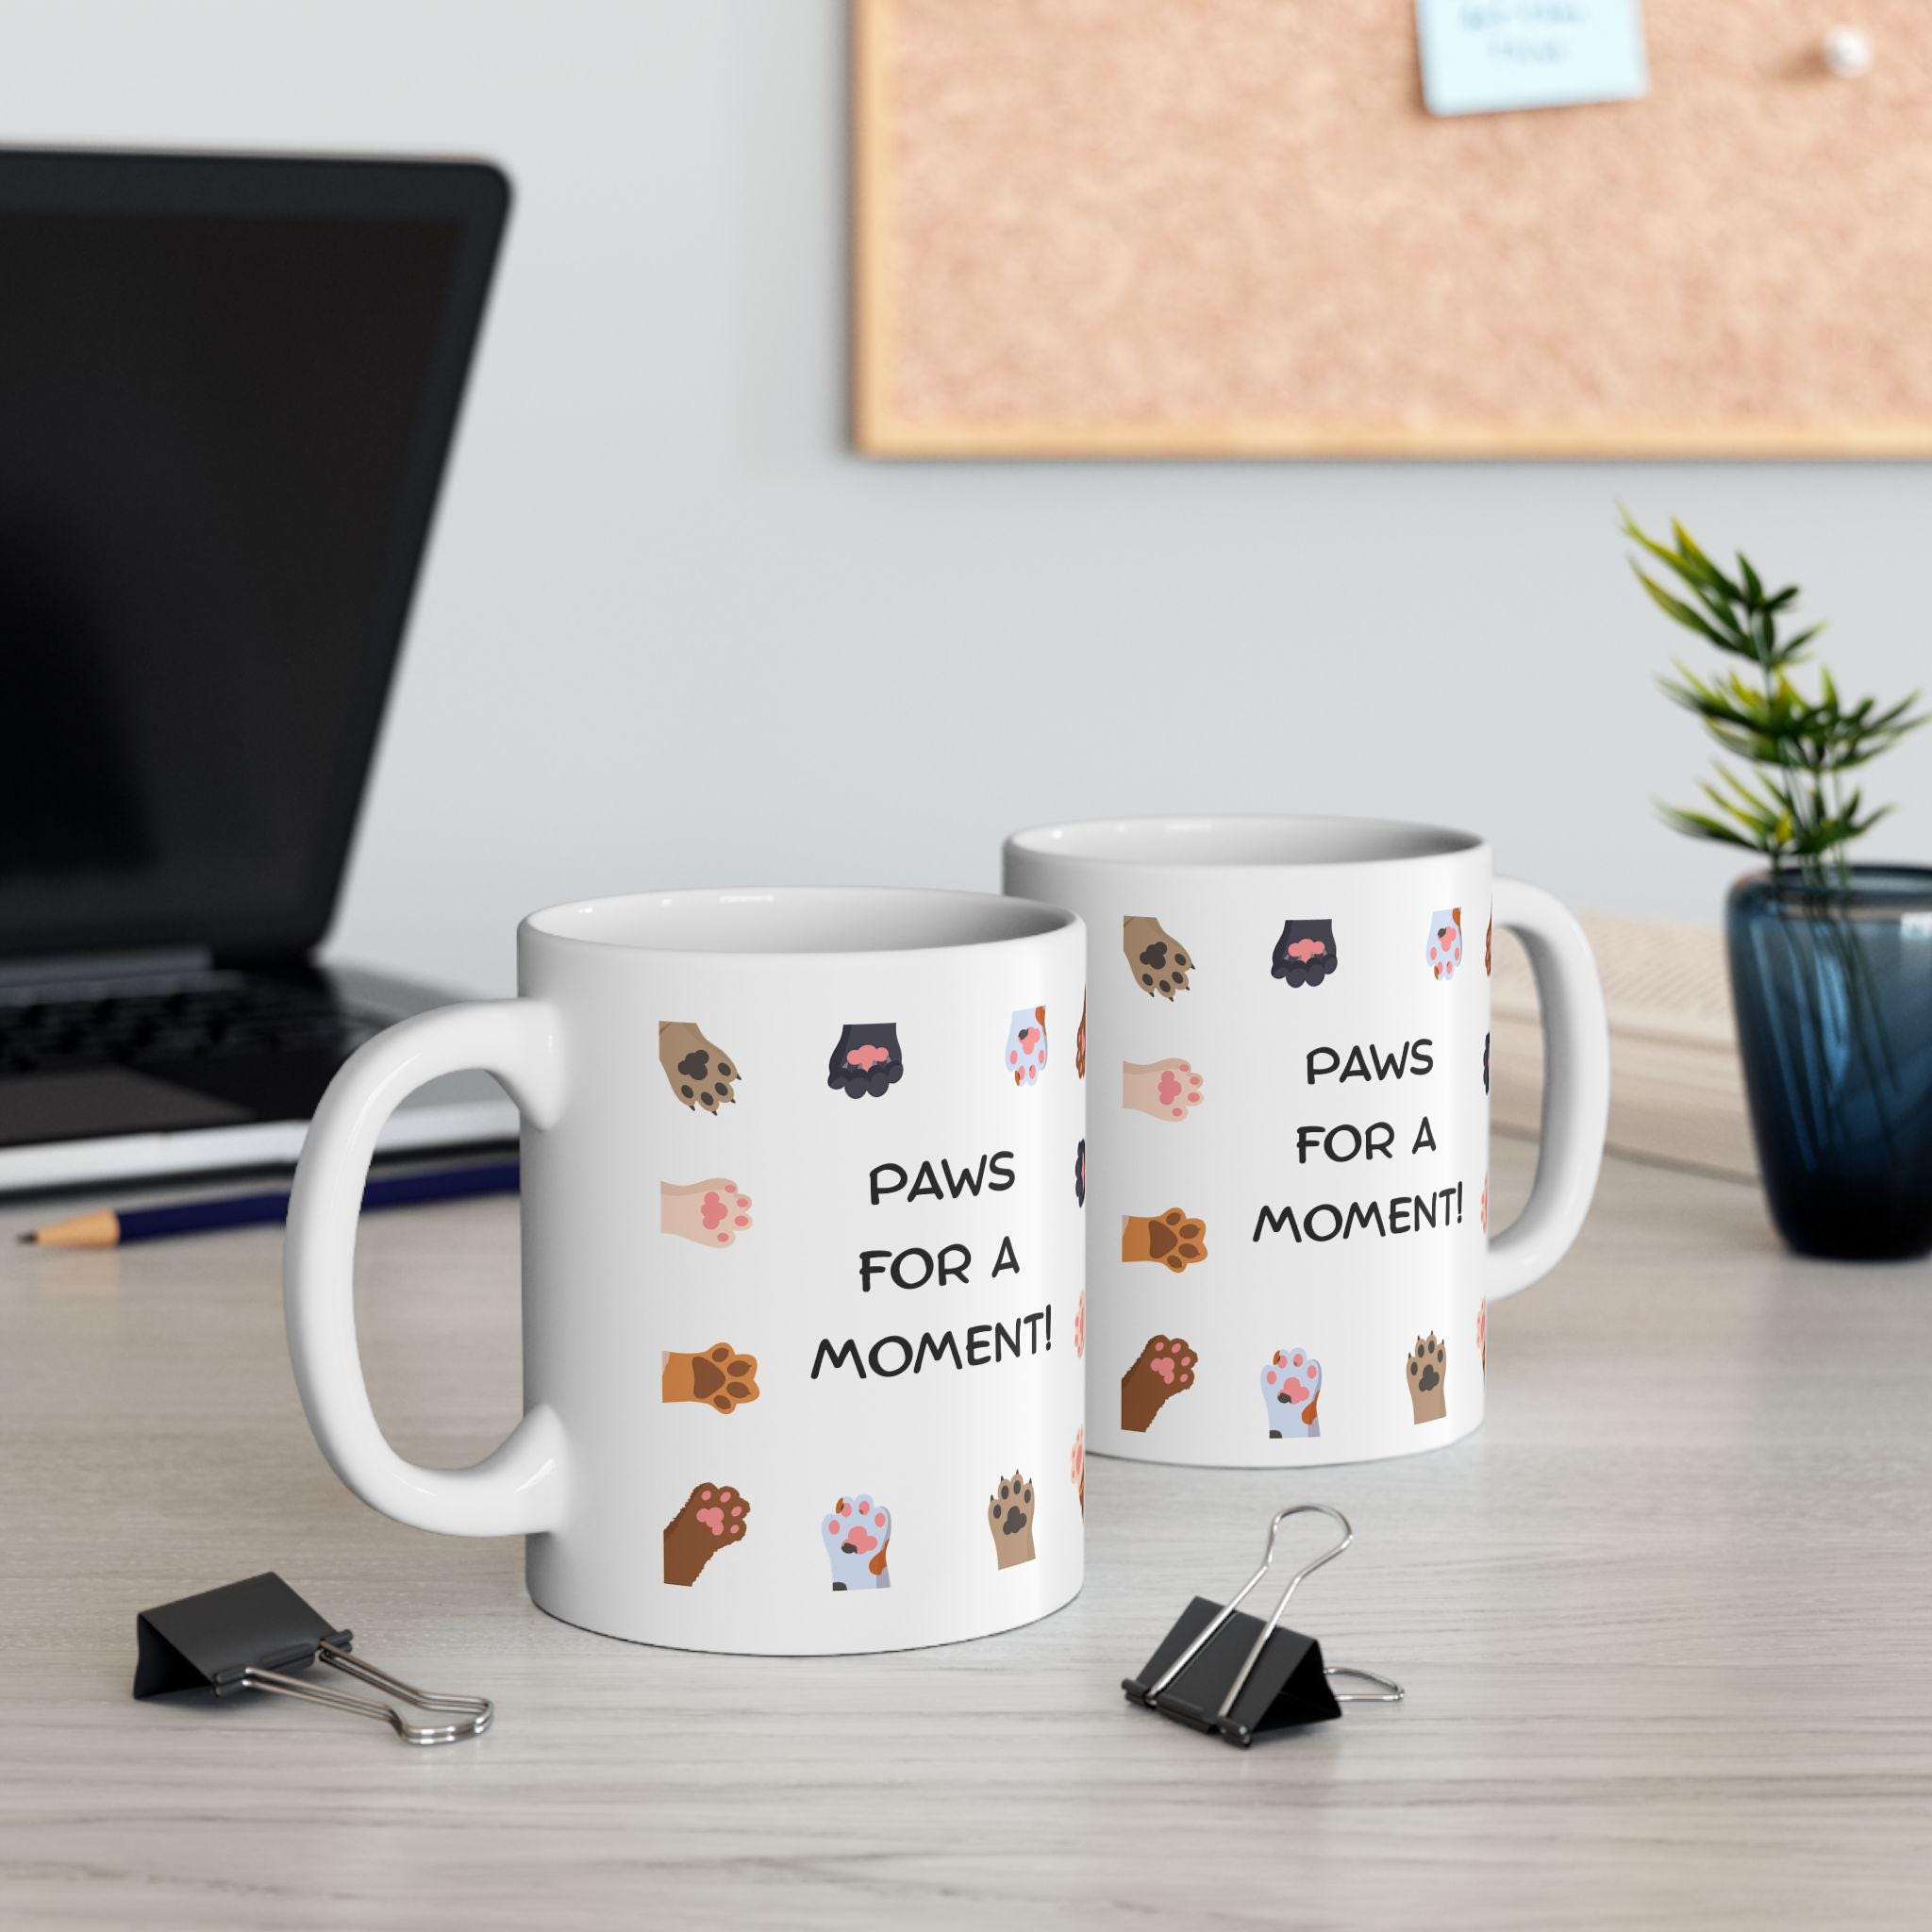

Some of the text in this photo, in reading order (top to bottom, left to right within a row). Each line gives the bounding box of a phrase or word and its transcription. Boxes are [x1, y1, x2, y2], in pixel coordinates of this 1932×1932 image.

[1306, 1038, 1434, 1085] PAWS
[1296, 1116, 1437, 1164] FOR A
[869, 1150, 1016, 1206] PAWS
[1252, 1180, 1463, 1243] MOMENT!
[858, 1236, 1021, 1292] FOR A
[810, 1304, 1052, 1380] MOMENT!
